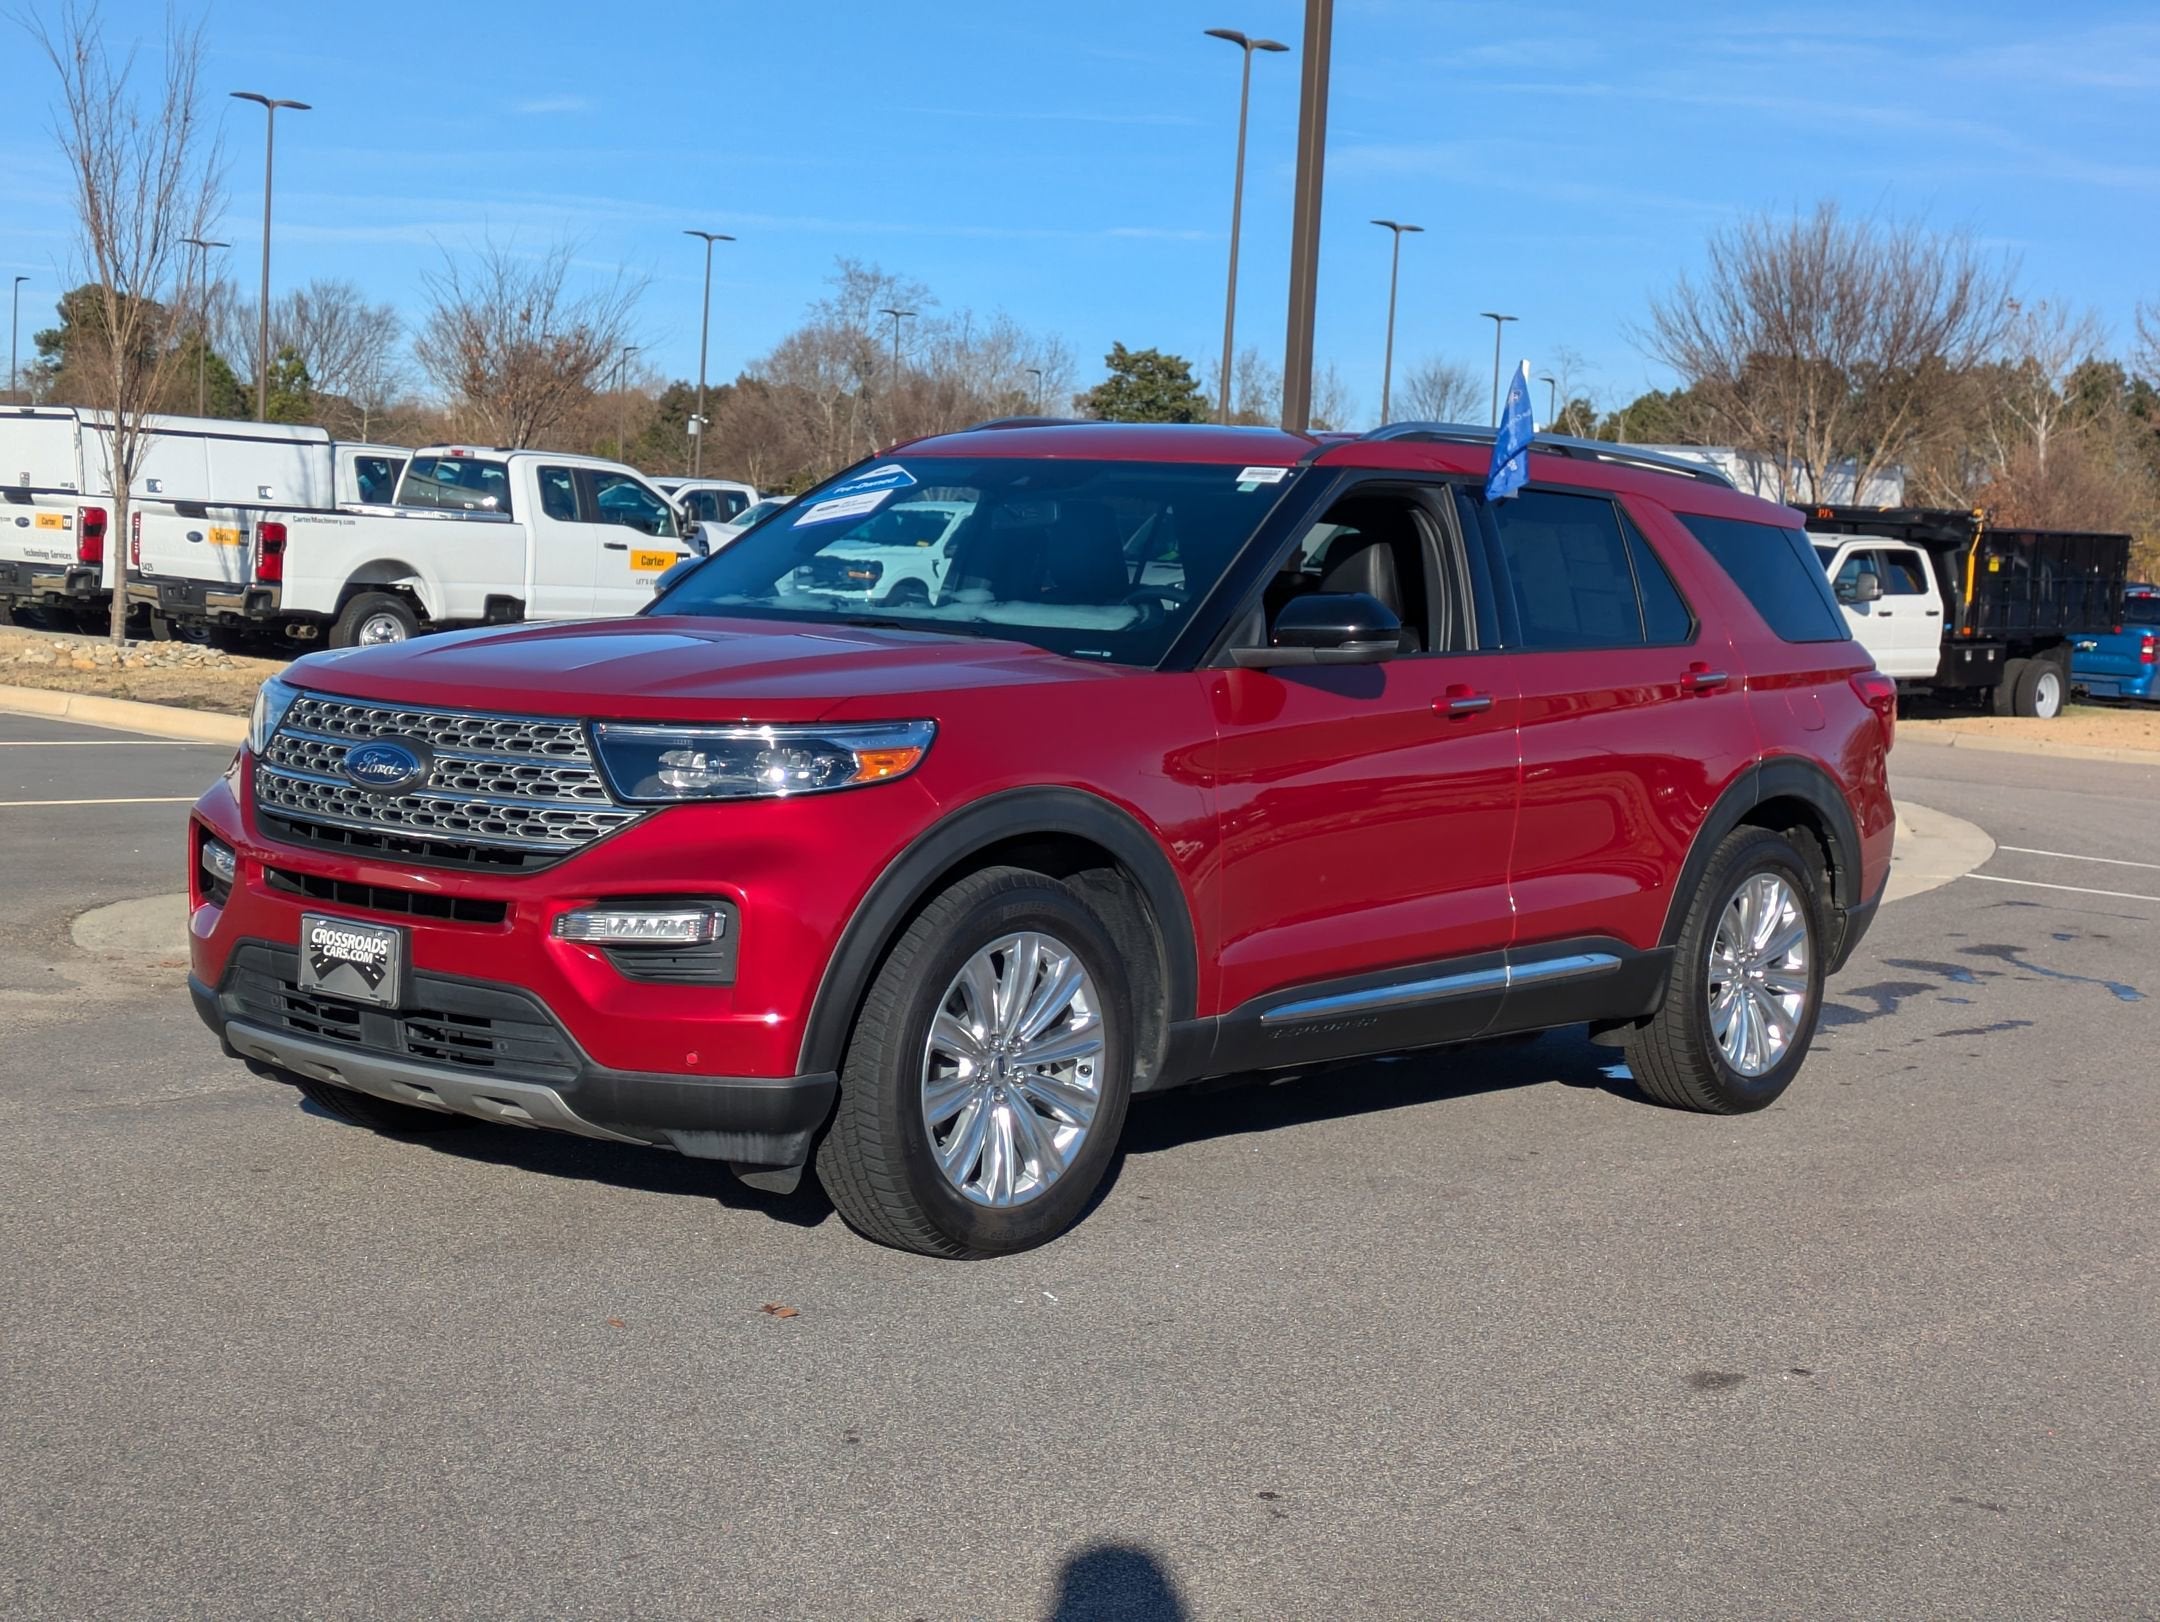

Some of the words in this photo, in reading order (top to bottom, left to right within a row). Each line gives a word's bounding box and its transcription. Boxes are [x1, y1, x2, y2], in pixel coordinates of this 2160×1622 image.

[50, 549, 72, 560] Services
[641, 555, 665, 567] Carter
[357, 750, 403, 776] Ford
[311, 927, 388, 955] CROSSROADS
[322, 944, 373, 964] CARS.COM
